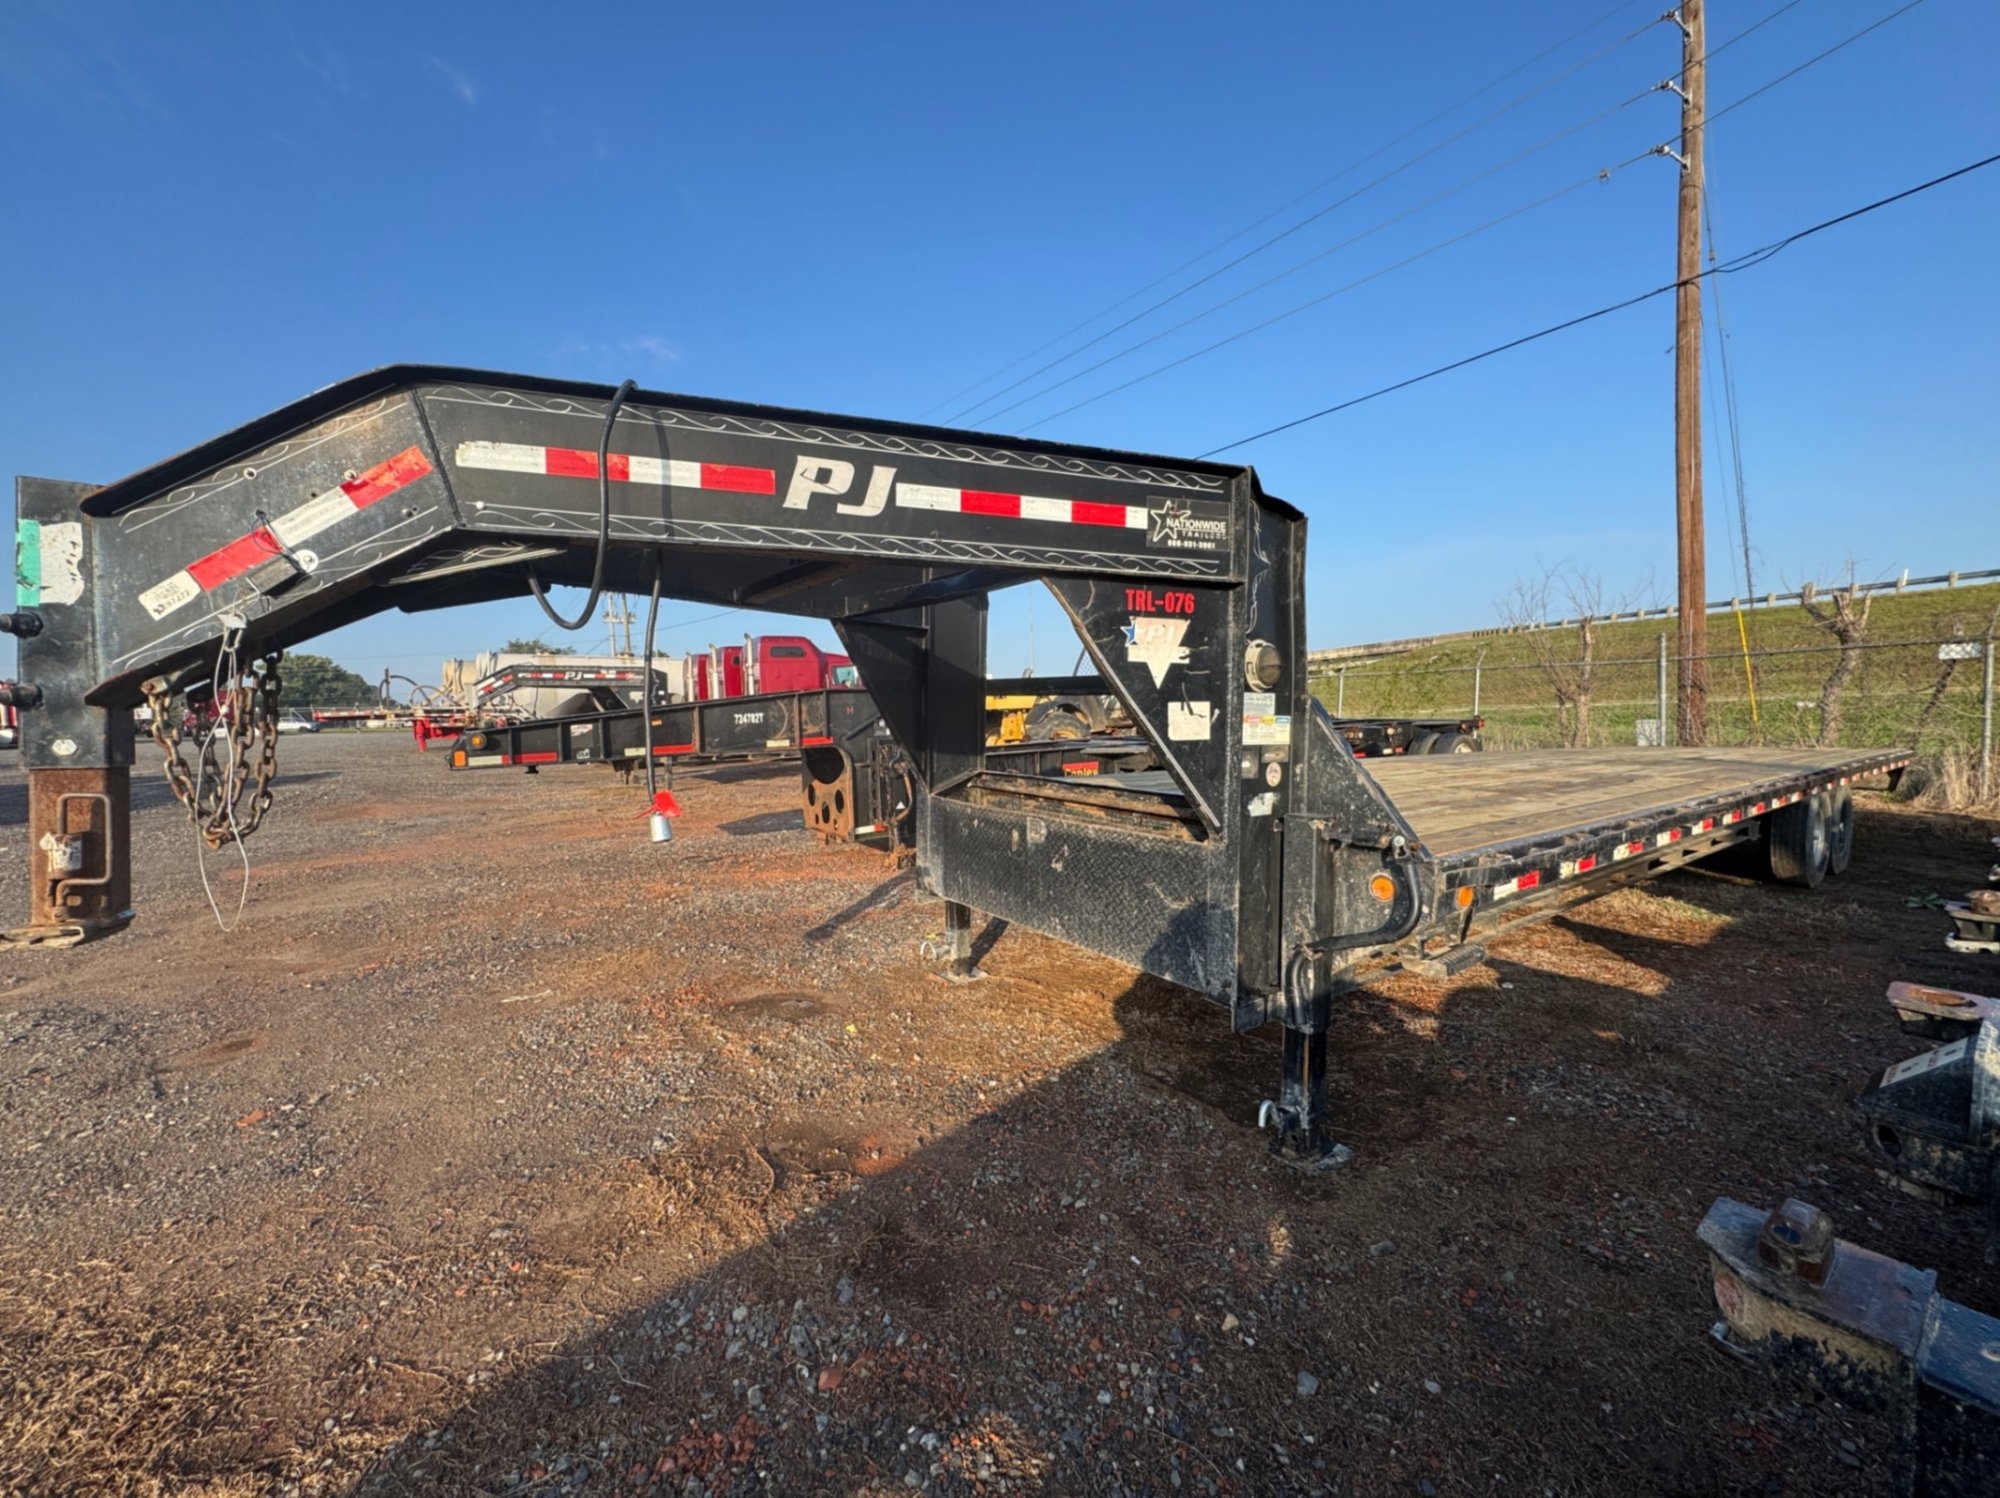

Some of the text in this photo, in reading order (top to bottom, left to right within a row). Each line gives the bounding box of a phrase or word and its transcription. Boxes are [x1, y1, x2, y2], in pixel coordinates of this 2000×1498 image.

[782, 455, 897, 517] PJ
[1166, 517, 1226, 531] NATIONWIDE
[1125, 589, 1195, 614] TRL-076
[564, 671, 583, 681] PJ
